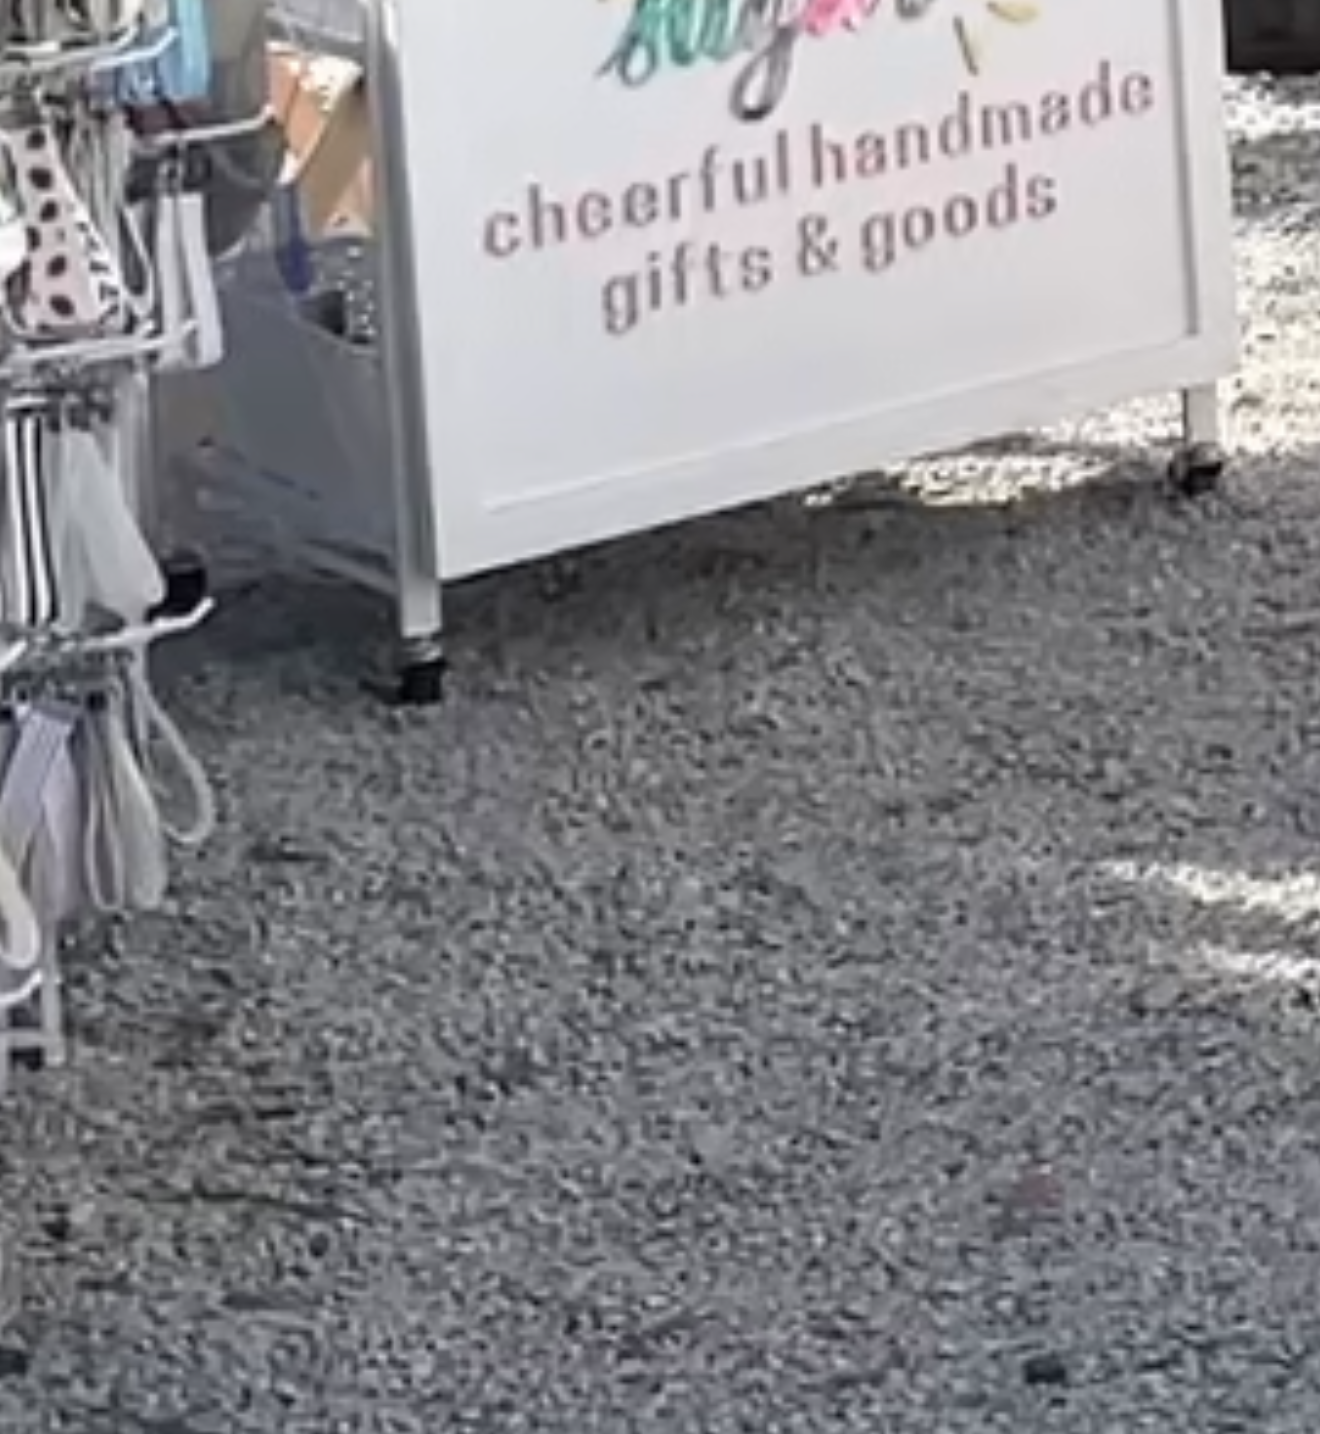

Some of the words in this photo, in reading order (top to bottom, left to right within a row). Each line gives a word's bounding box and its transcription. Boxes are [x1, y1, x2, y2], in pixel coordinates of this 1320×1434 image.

[482, 131, 792, 260] cheerful
[809, 60, 1156, 188] handmade
[602, 240, 773, 335] gifts
[796, 214, 839, 277] &
[861, 164, 1060, 269] goods
